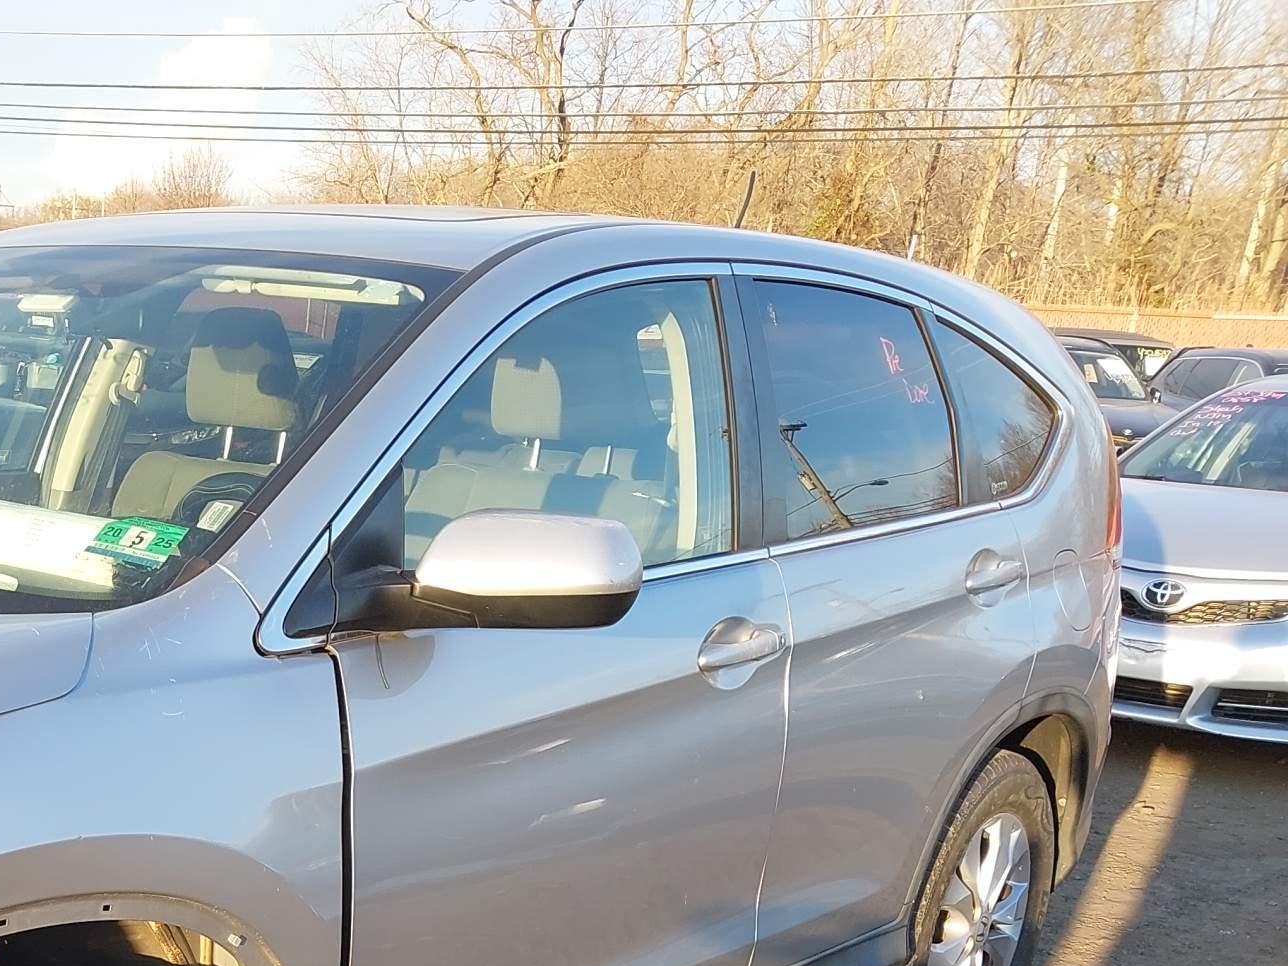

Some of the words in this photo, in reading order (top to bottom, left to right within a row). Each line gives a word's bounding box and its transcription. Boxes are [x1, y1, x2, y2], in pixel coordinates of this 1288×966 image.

[103, 526, 123, 539] 20
[131, 530, 149, 546] 5
[152, 537, 173, 549] 25
